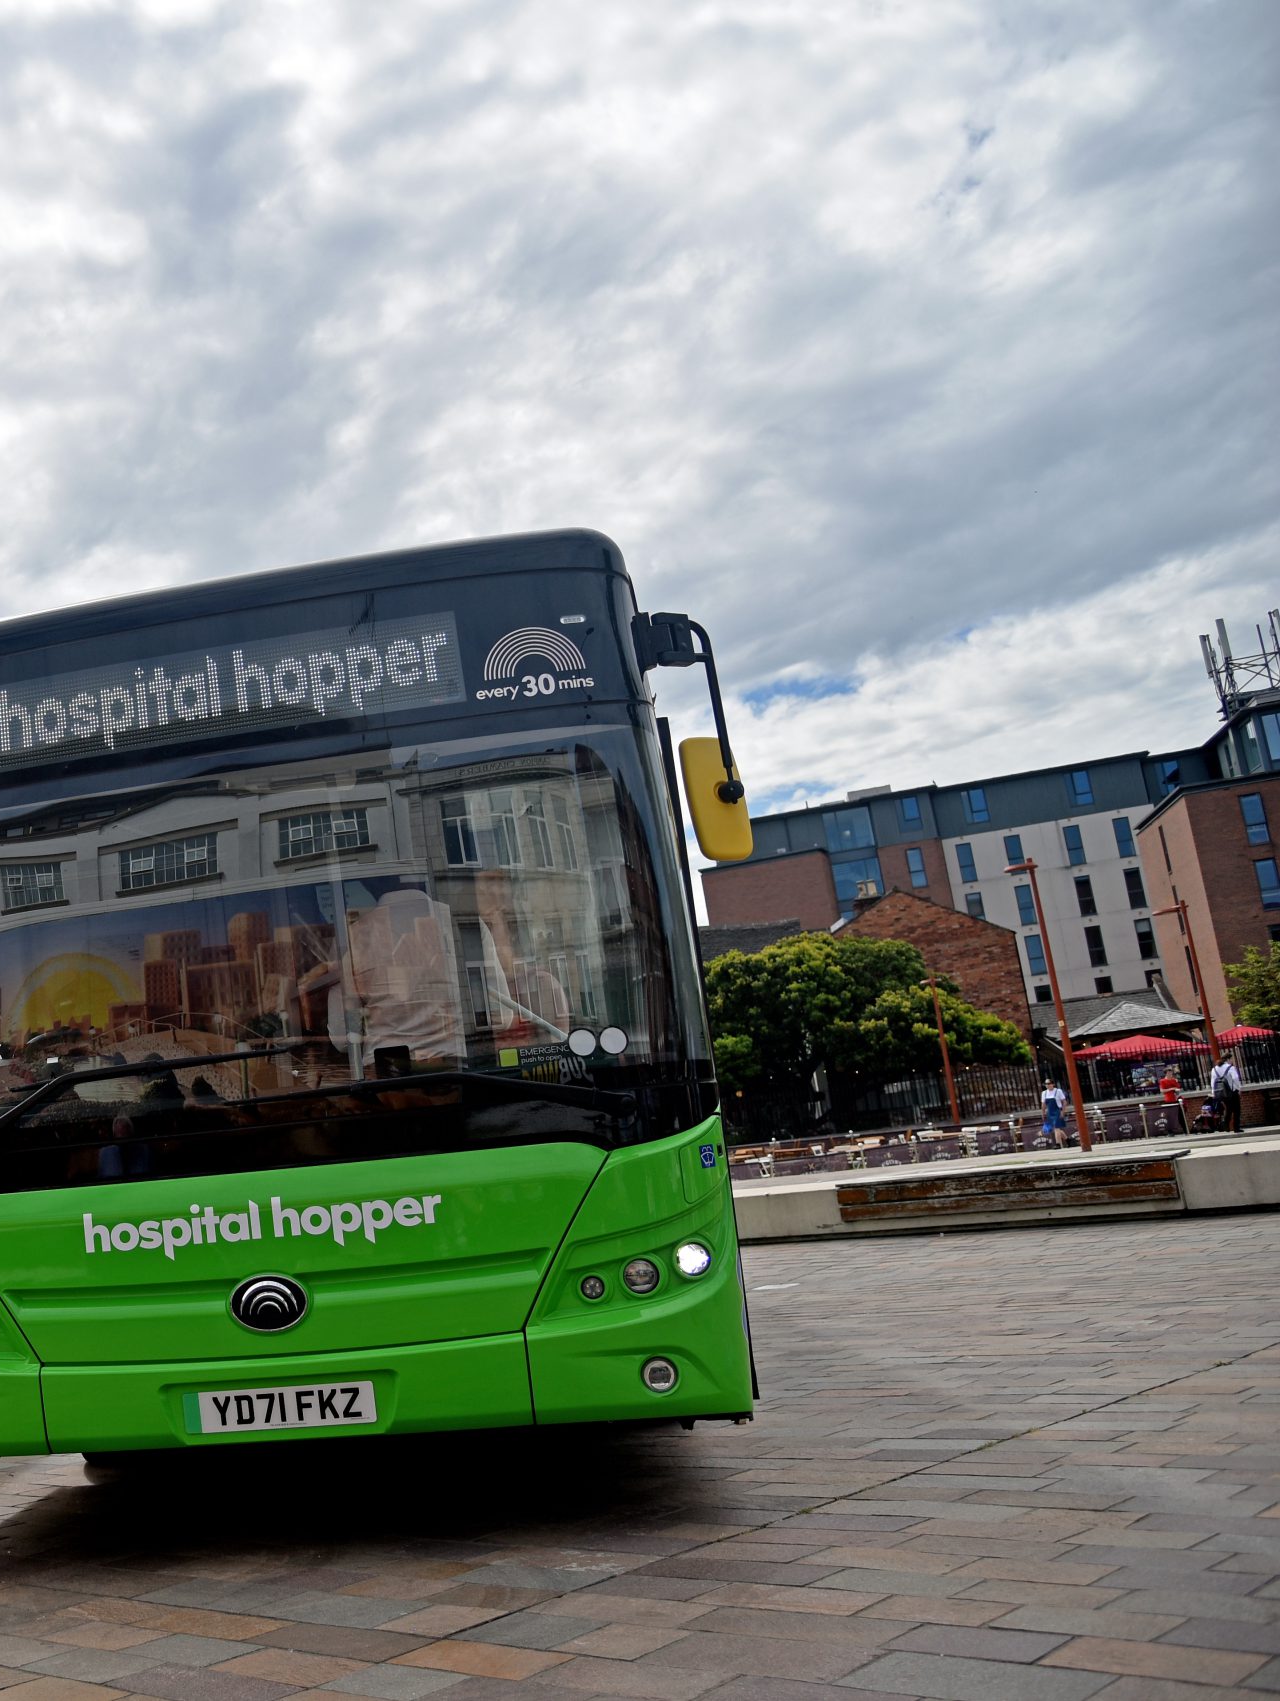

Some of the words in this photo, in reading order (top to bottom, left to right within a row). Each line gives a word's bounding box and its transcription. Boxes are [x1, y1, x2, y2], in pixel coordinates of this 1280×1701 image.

[232, 632, 447, 717] hopper
[476, 685, 519, 700] every
[521, 673, 555, 697] 30
[558, 675, 595, 690] mins
[520, 1044, 570, 1057] EMERGENC
[521, 1057, 537, 1065] push
[546, 1053, 563, 1063] open
[83, 1199, 262, 1261] hospital
[270, 1194, 442, 1247] hopper
[212, 1391, 288, 1427] YD71
[295, 1386, 363, 1422] FKZ
